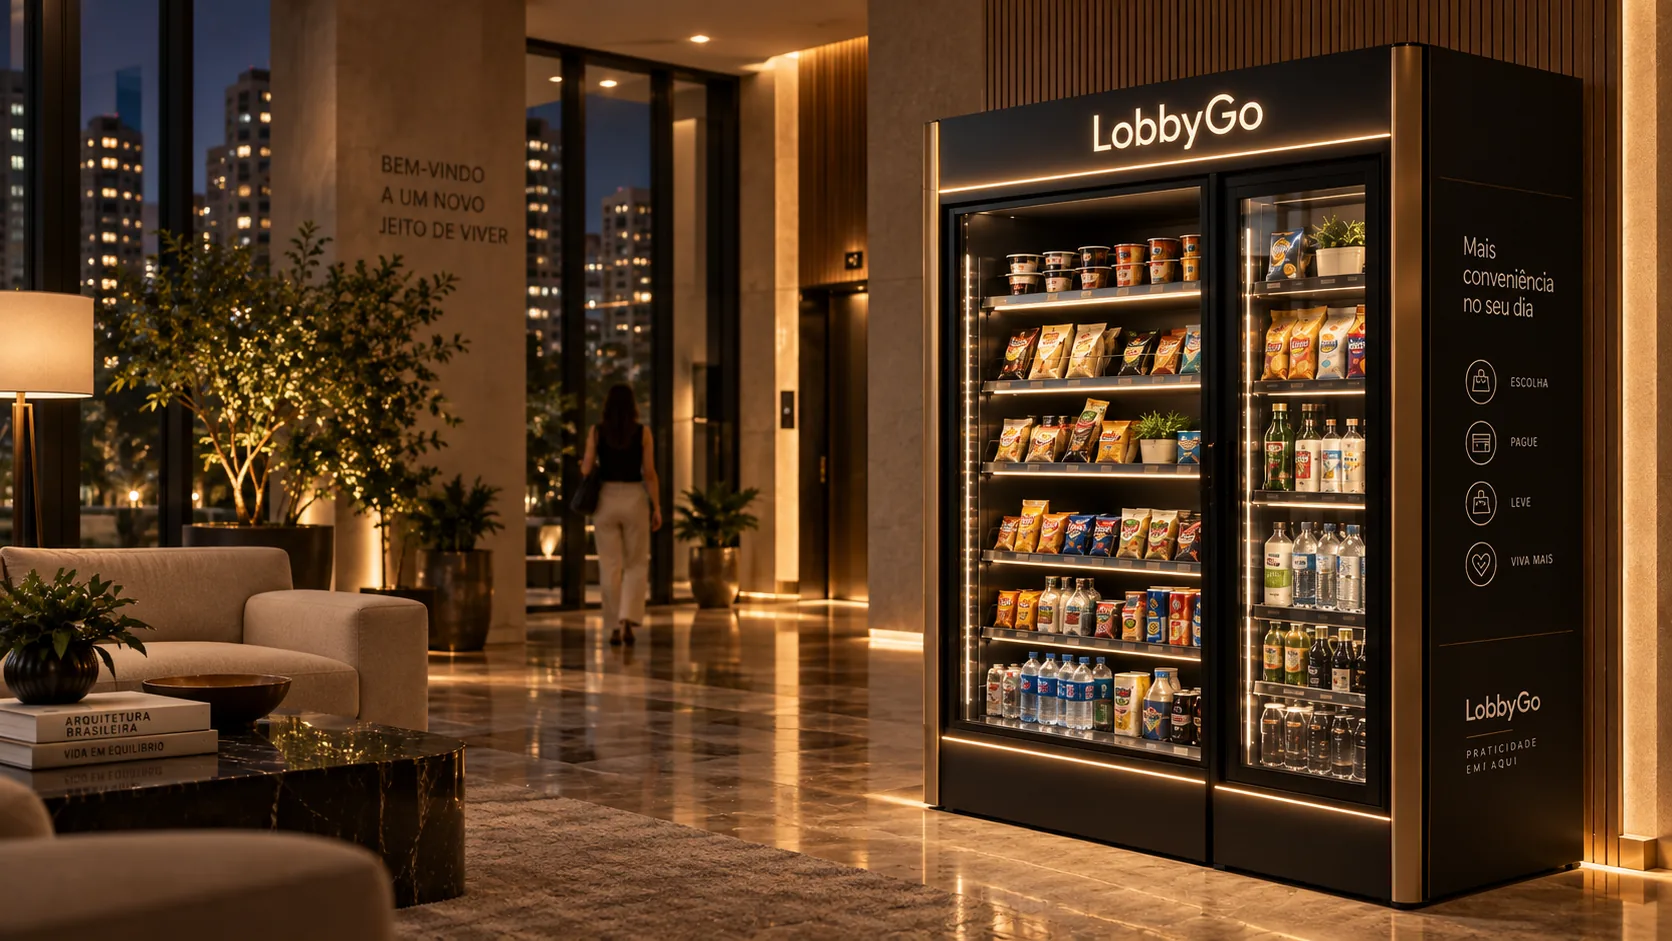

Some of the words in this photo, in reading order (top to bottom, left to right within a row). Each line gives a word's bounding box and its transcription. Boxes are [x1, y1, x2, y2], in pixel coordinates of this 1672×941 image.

[1092, 93, 1264, 152] LobbyGo
[382, 155, 485, 184] BEM-VINDO
[381, 186, 394, 204] A
[400, 188, 428, 208] UM
[434, 191, 485, 213] NOVO
[379, 216, 427, 238] JEITO
[433, 221, 455, 240] DE
[460, 224, 508, 244] VIVER
[1463, 235, 1497, 260] Mais
[1463, 268, 1554, 293] conveniência
[1463, 297, 1482, 314] no
[1485, 299, 1510, 316] seu
[1513, 296, 1534, 318] dia
[1510, 376, 1549, 389] ESCOLHA
[1510, 436, 1538, 448] PAGUE
[1510, 496, 1531, 508] LEVE
[1511, 555, 1531, 567] VIVA
[1532, 553, 1554, 566] MAIS
[1466, 690, 1541, 722] LobbyGo
[65, 711, 151, 726] ARQUITETURA
[66, 723, 138, 738] BRASILEIRA
[64, 747, 88, 760] VIDA
[91, 746, 105, 758] EM
[1466, 737, 1537, 759] PRATICIDADE
[1491, 756, 1517, 770] AQUI
